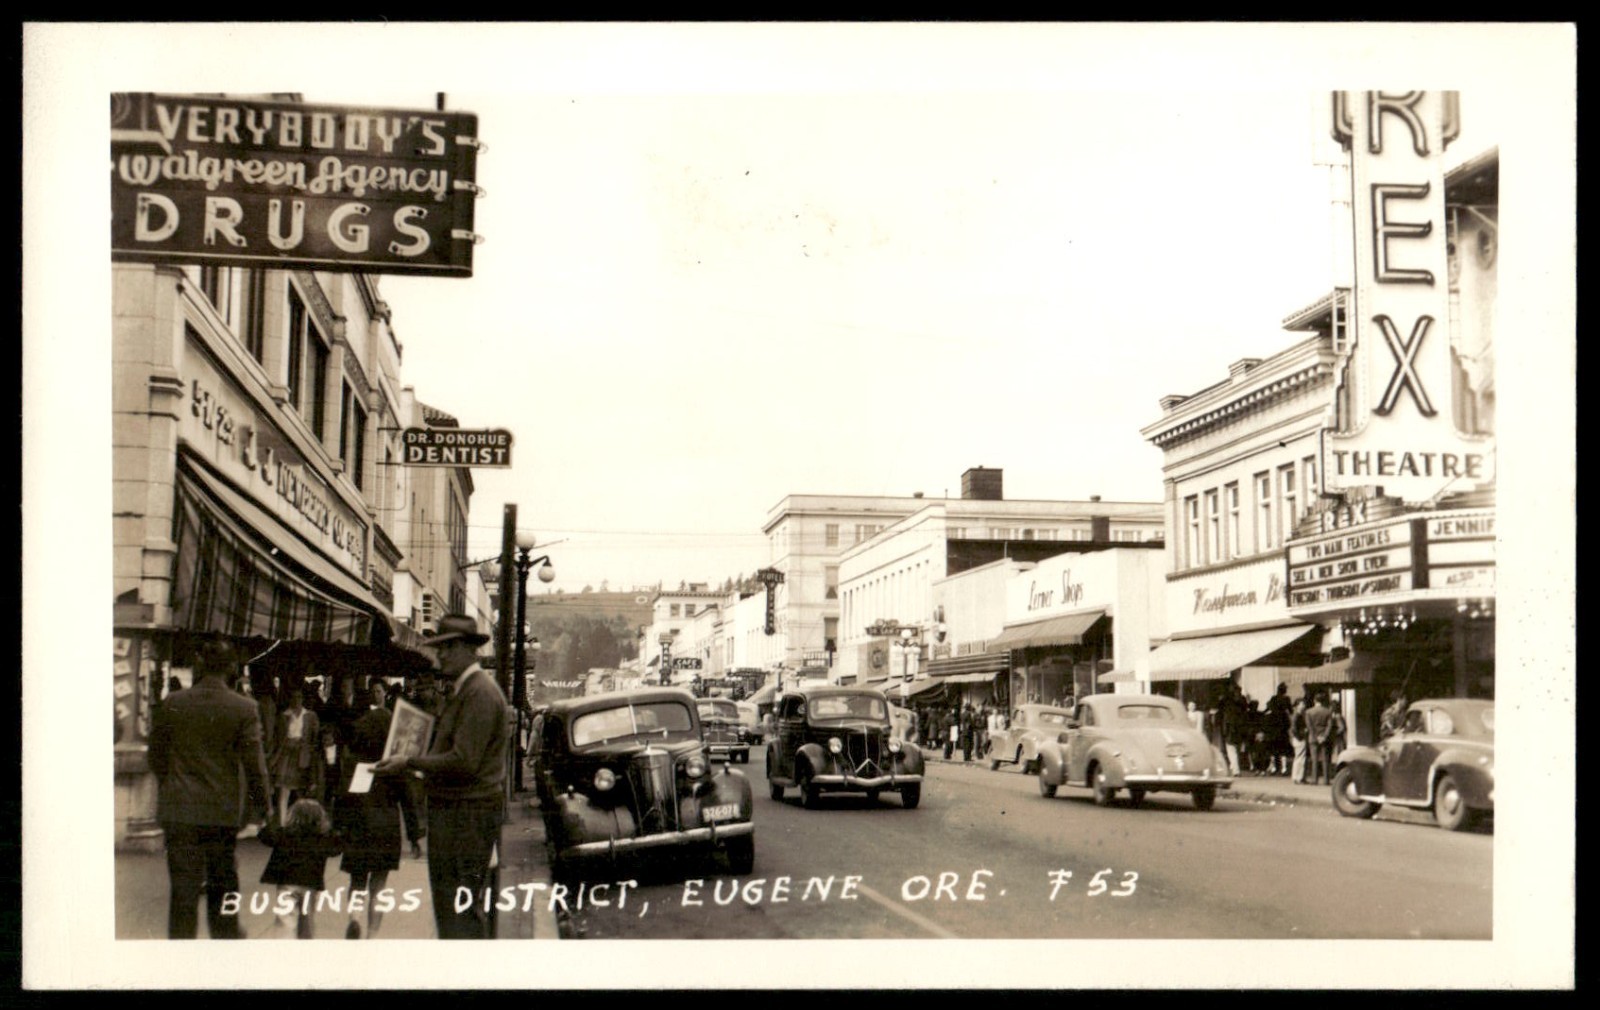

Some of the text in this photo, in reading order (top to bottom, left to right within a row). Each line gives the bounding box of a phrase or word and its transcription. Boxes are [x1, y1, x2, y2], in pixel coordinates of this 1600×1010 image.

[119, 150, 448, 201] Walgreen Agency
[135, 193, 431, 257] DRUGS
[1367, 91, 1438, 418] REX
[407, 432, 507, 446] DR. DONOHUE
[409, 446, 506, 465] DENTIST
[1333, 450, 1484, 479] THEATRE
[1323, 501, 1366, 533] REX
[1306, 529, 1390, 558] TWO MAIN FEATURES
[1293, 569, 1306, 583] SEE
[1309, 567, 1314, 580] A
[1319, 564, 1333, 579] NEW
[1338, 560, 1357, 576] SHOW
[1028, 568, 1085, 612] Lerner Shops
